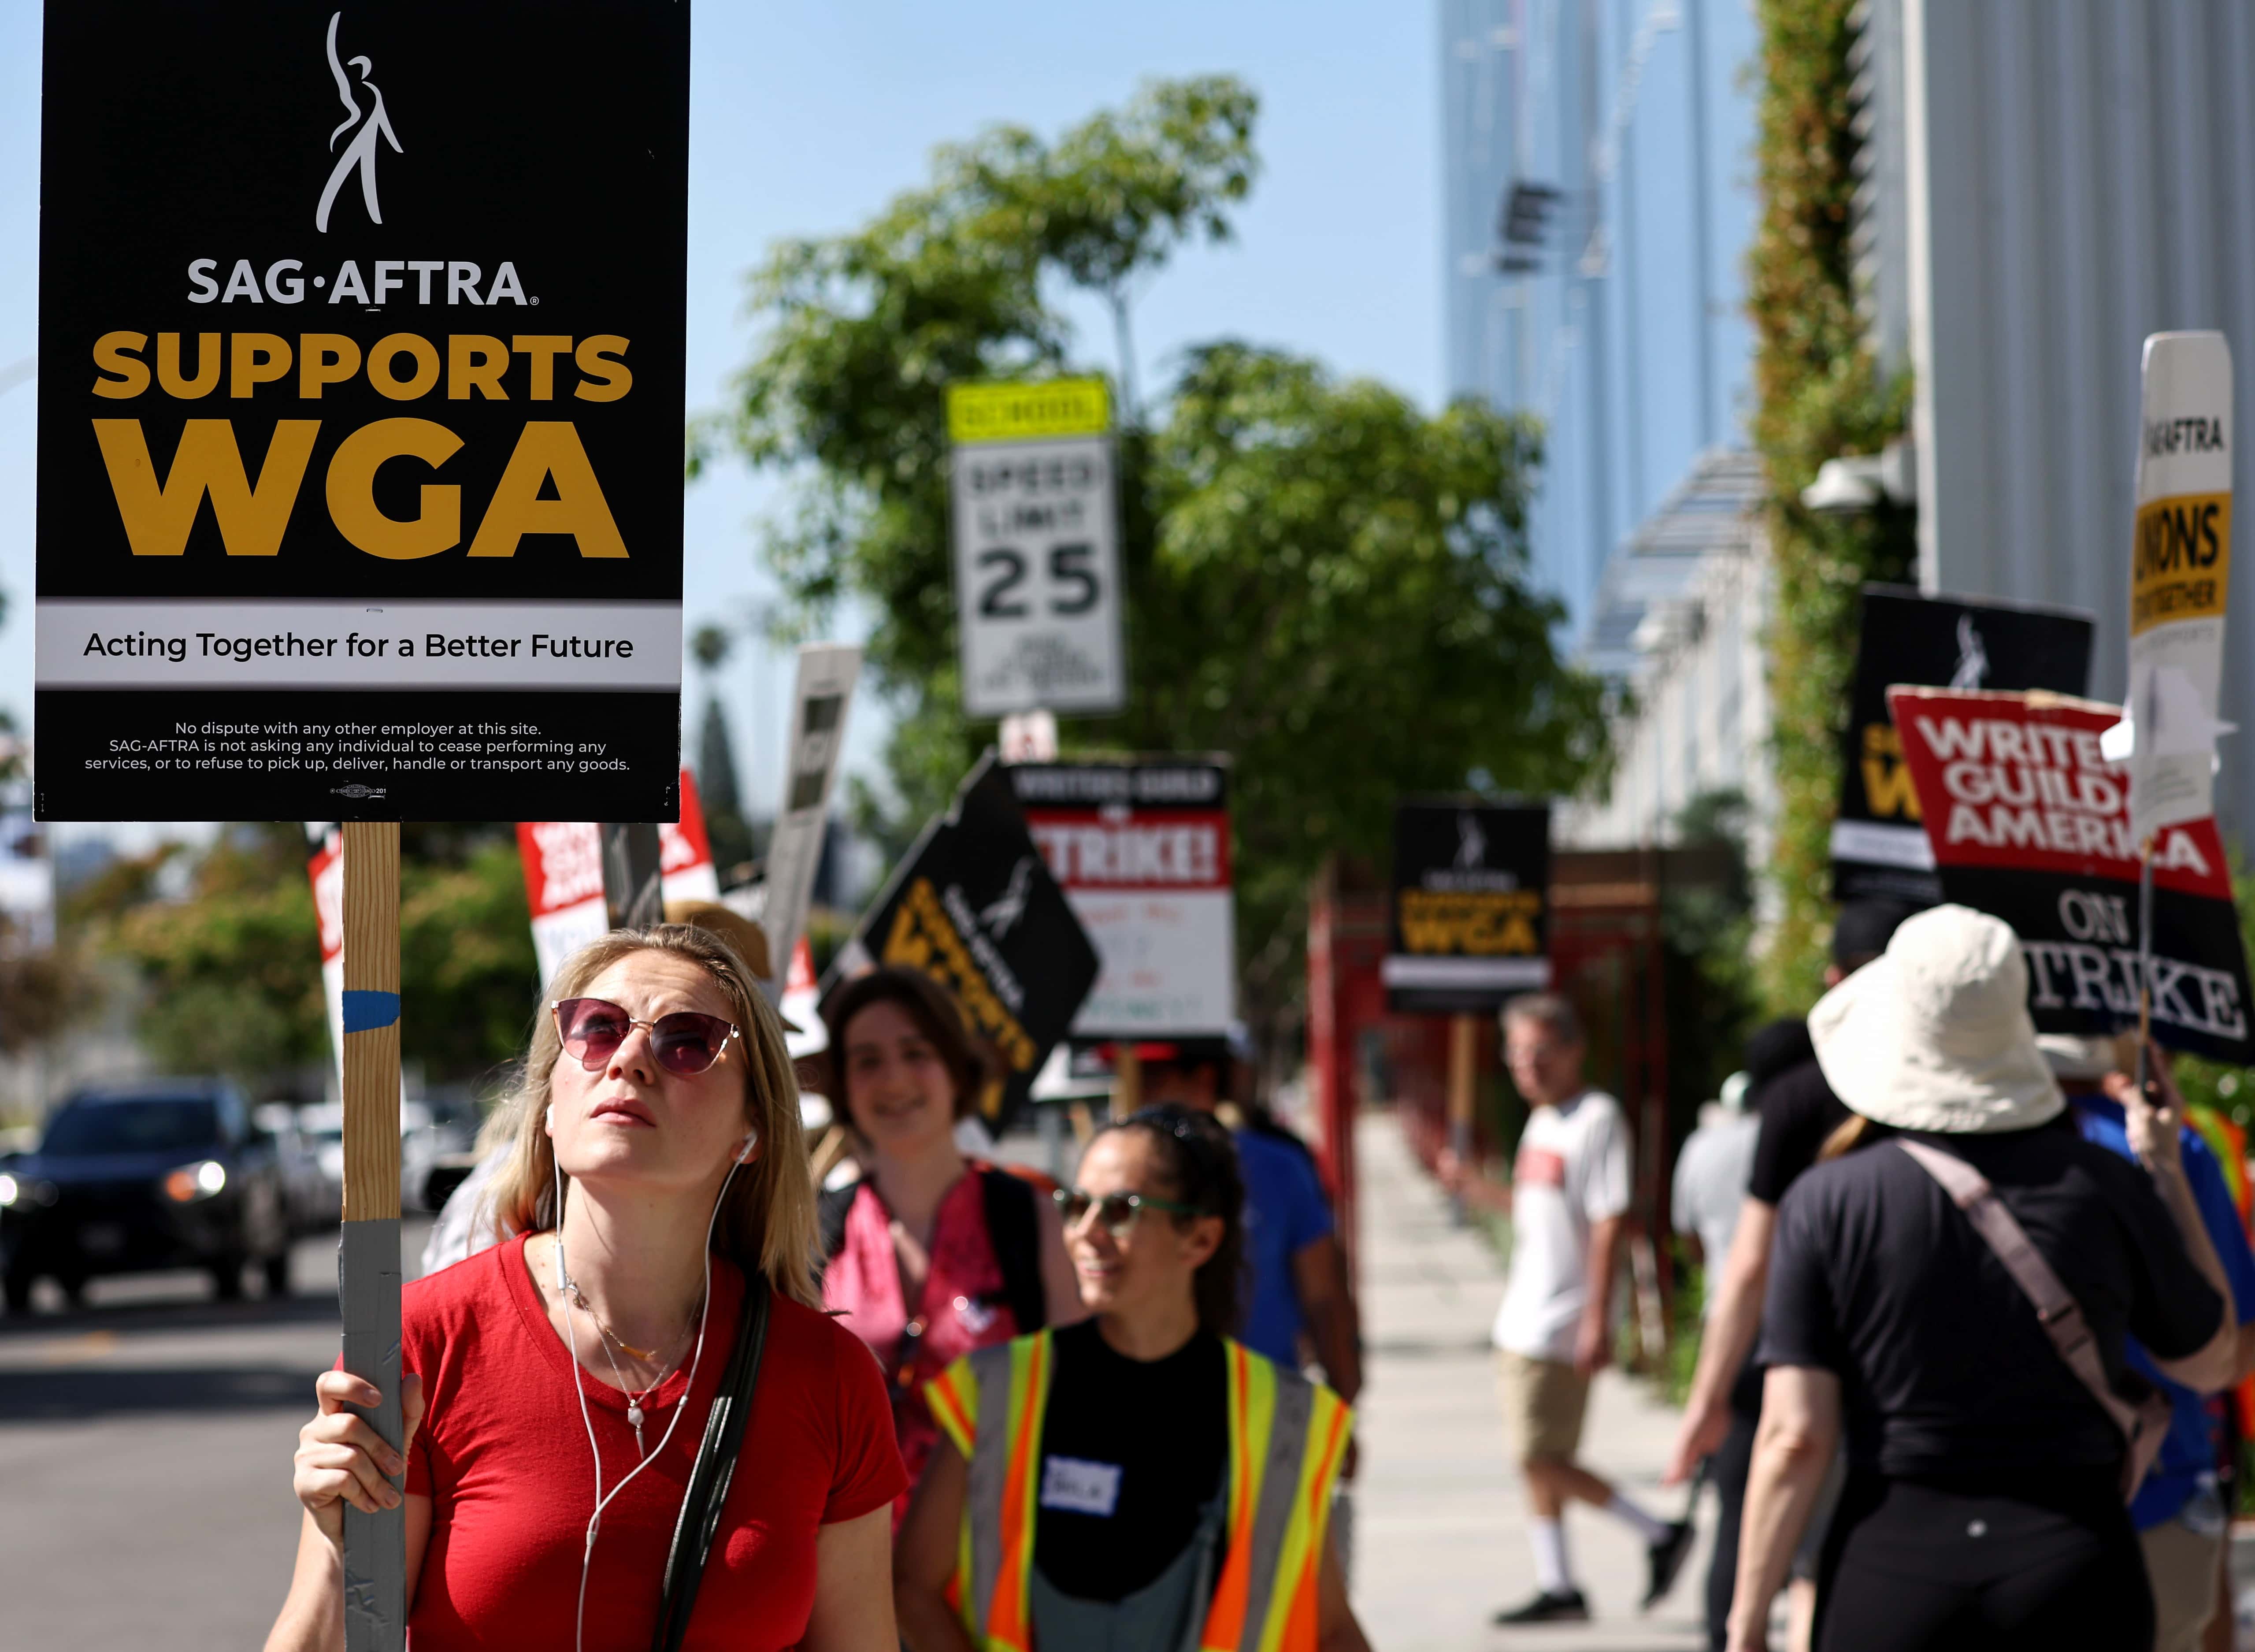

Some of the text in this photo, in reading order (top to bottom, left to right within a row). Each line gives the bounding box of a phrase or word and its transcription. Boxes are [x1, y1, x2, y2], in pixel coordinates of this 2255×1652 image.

[92, 331, 632, 402] SUPPORTS
[92, 417, 630, 560] WGA
[972, 457, 1094, 493] SPEED
[978, 498, 1085, 538] LIMIT
[977, 543, 1102, 618] 25
[83, 631, 633, 662] Acting Together for a Better Future
[110, 740, 199, 751] SAG-AFTRA
[204, 739, 215, 751] is
[221, 741, 245, 751] not
[251, 739, 300, 754] asking
[307, 743, 334, 754] any
[339, 740, 413, 752] individual
[419, 742, 434, 751] to
[487, 740, 573, 755] performing
[579, 744, 606, 755] any
[176, 722, 541, 737] No dispute with any other employer at this site.
[1915, 716, 2129, 778] WRITE
[85, 757, 629, 772] services, or to refuse to pick up, deliver, handle or transport any goods.
[1943, 761, 2121, 816] GUILD
[1029, 824, 1217, 882] TRIKE!
[2058, 890, 2130, 946] ON
[2023, 941, 2248, 1042] TRIKE
